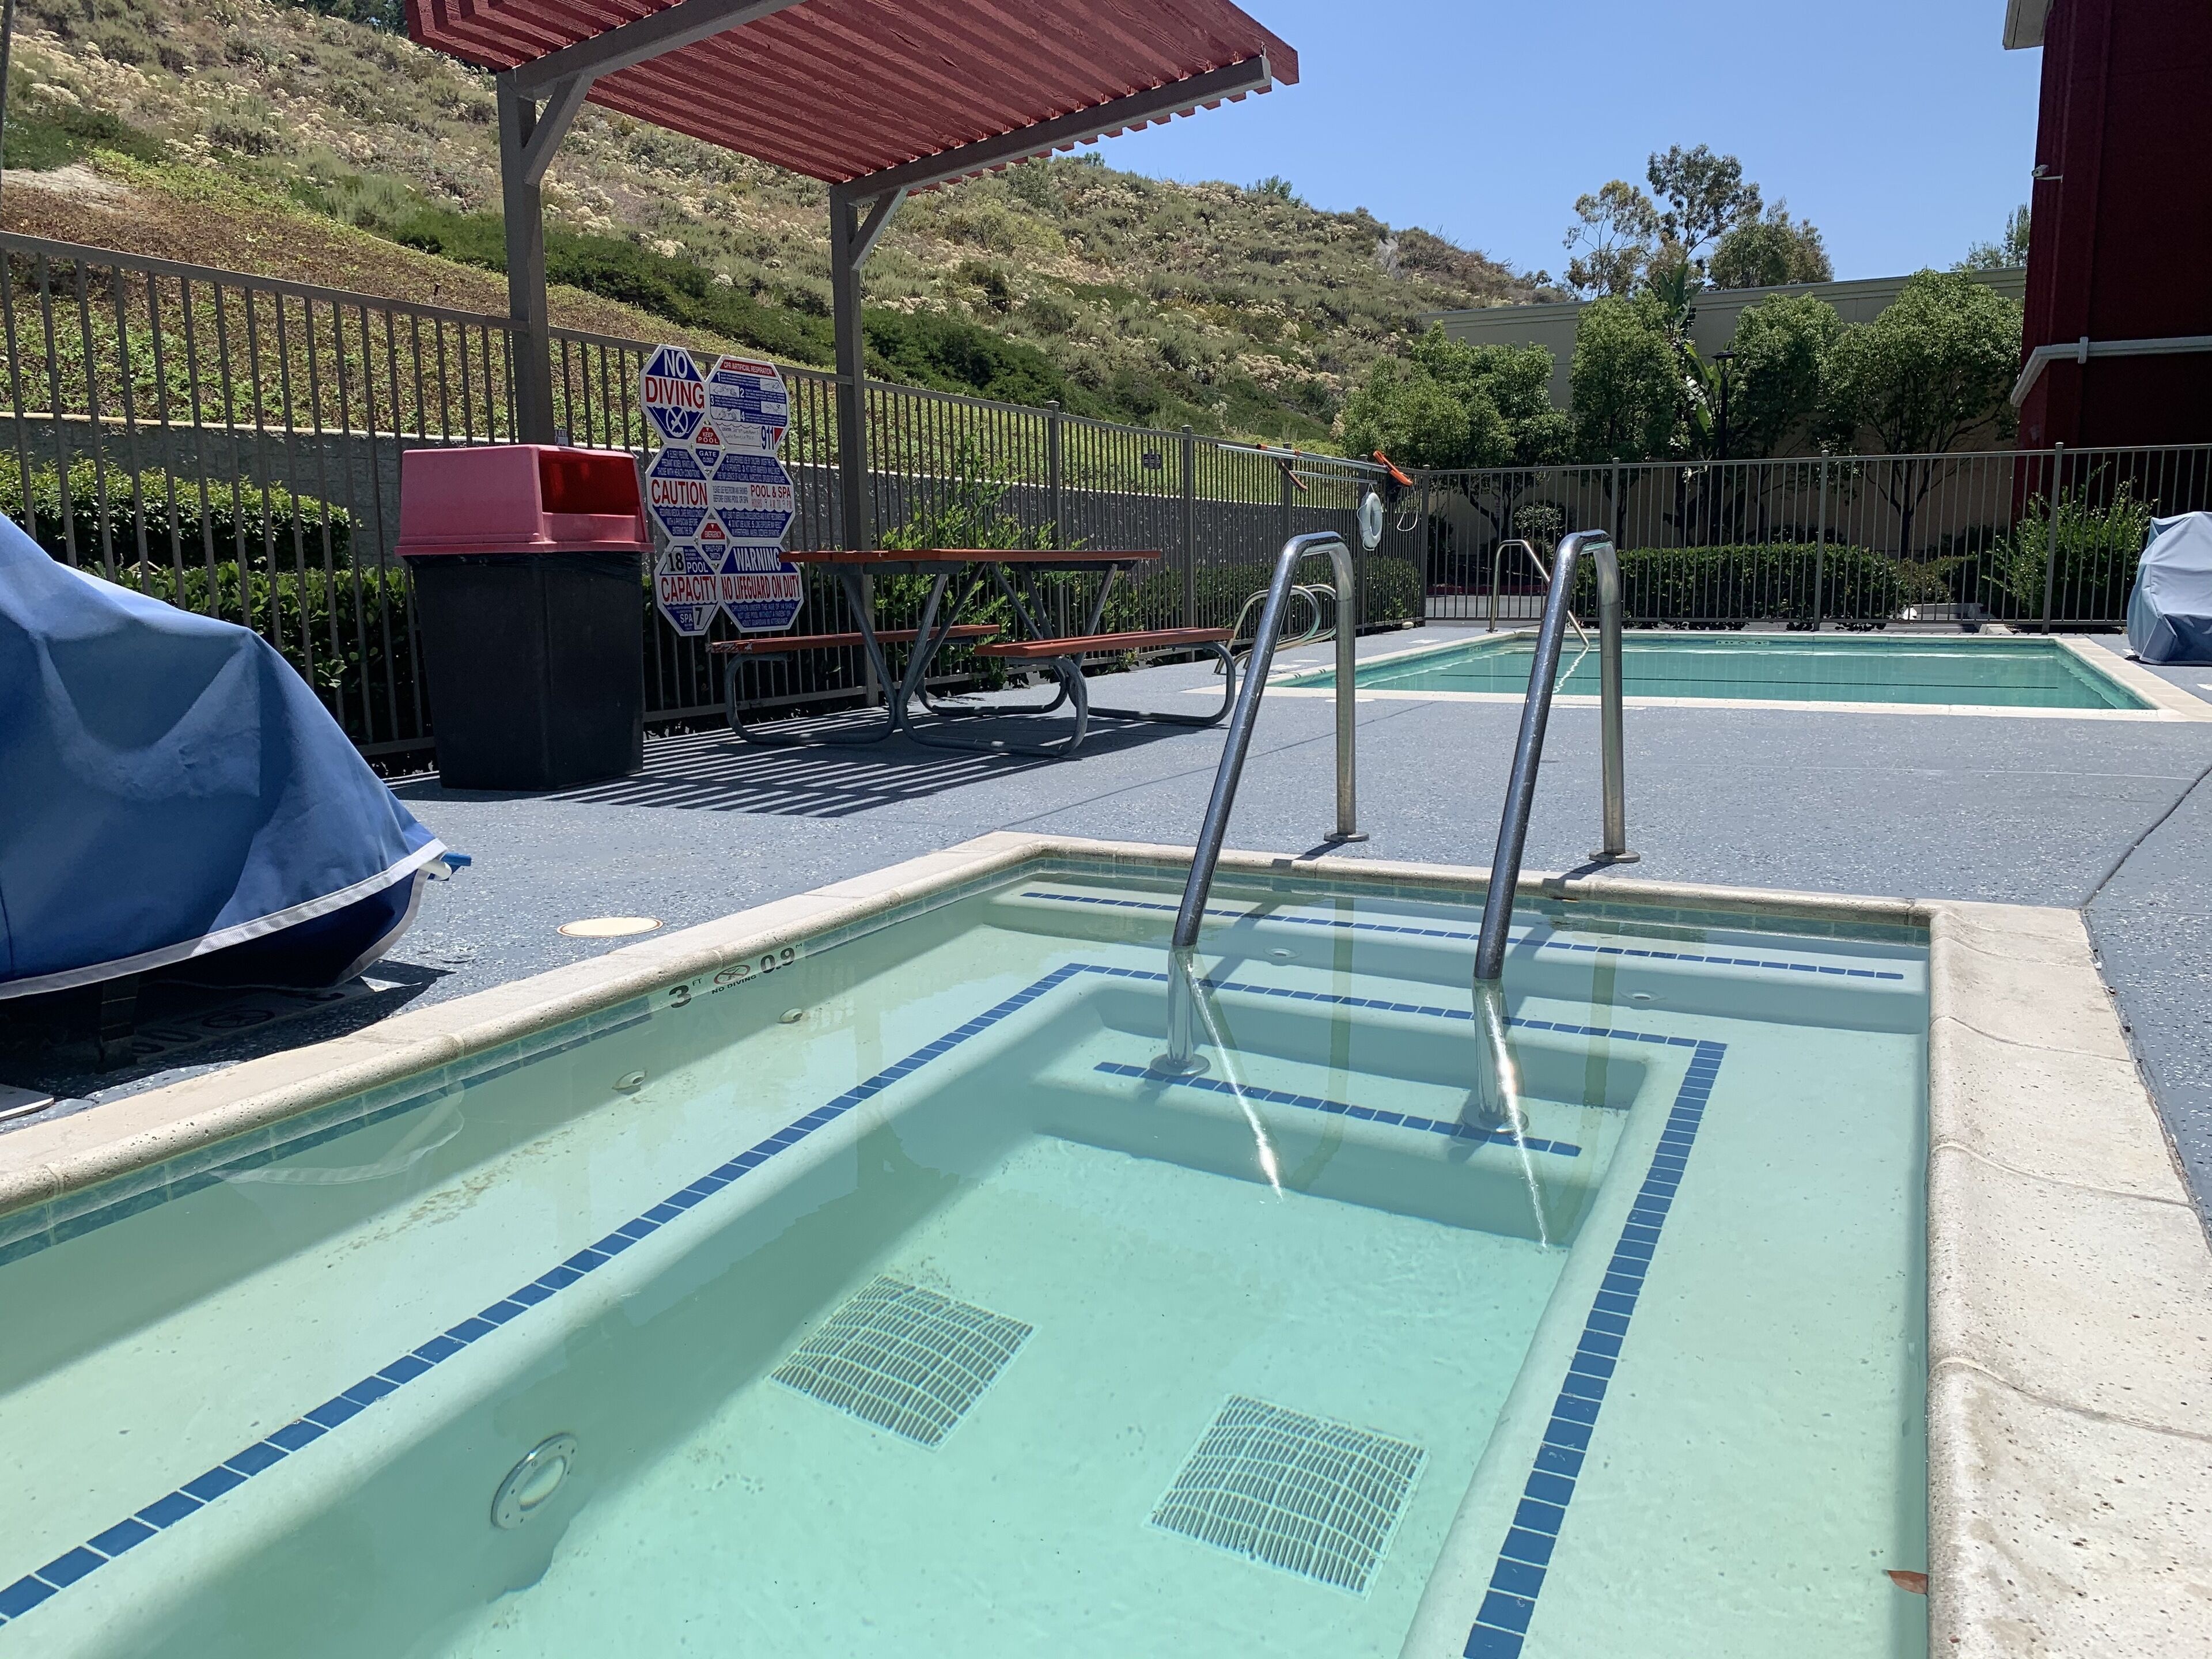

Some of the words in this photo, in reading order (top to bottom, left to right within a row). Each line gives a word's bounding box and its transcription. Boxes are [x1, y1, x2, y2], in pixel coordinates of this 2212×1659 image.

[664, 349, 688, 378] NO
[717, 372, 721, 381] 1
[645, 376, 704, 408] DIVING
[710, 395, 714, 405] 3
[740, 388, 745, 398] 2
[741, 411, 745, 421] 4
[761, 426, 774, 450] 911
[652, 479, 707, 505] CAUTION
[751, 484, 771, 497] POOL
[772, 486, 777, 498] &
[778, 486, 791, 498] SPA
[668, 552, 684, 571] 18
[687, 562, 709, 573] POOL
[733, 548, 781, 571] WARNING
[661, 576, 716, 602] CAPACITY
[721, 576, 733, 600] NO
[734, 575, 770, 599] LIFEGUARD
[772, 575, 782, 598] ON
[783, 575, 800, 598] DUTY
[680, 613, 693, 623] SPA
[695, 607, 703, 625] 7
[760, 947, 795, 974] 0.9
[669, 984, 692, 1008] 3
[692, 978, 702, 986] FT
[712, 986, 724, 994] NO
[727, 975, 756, 989] DIVING
